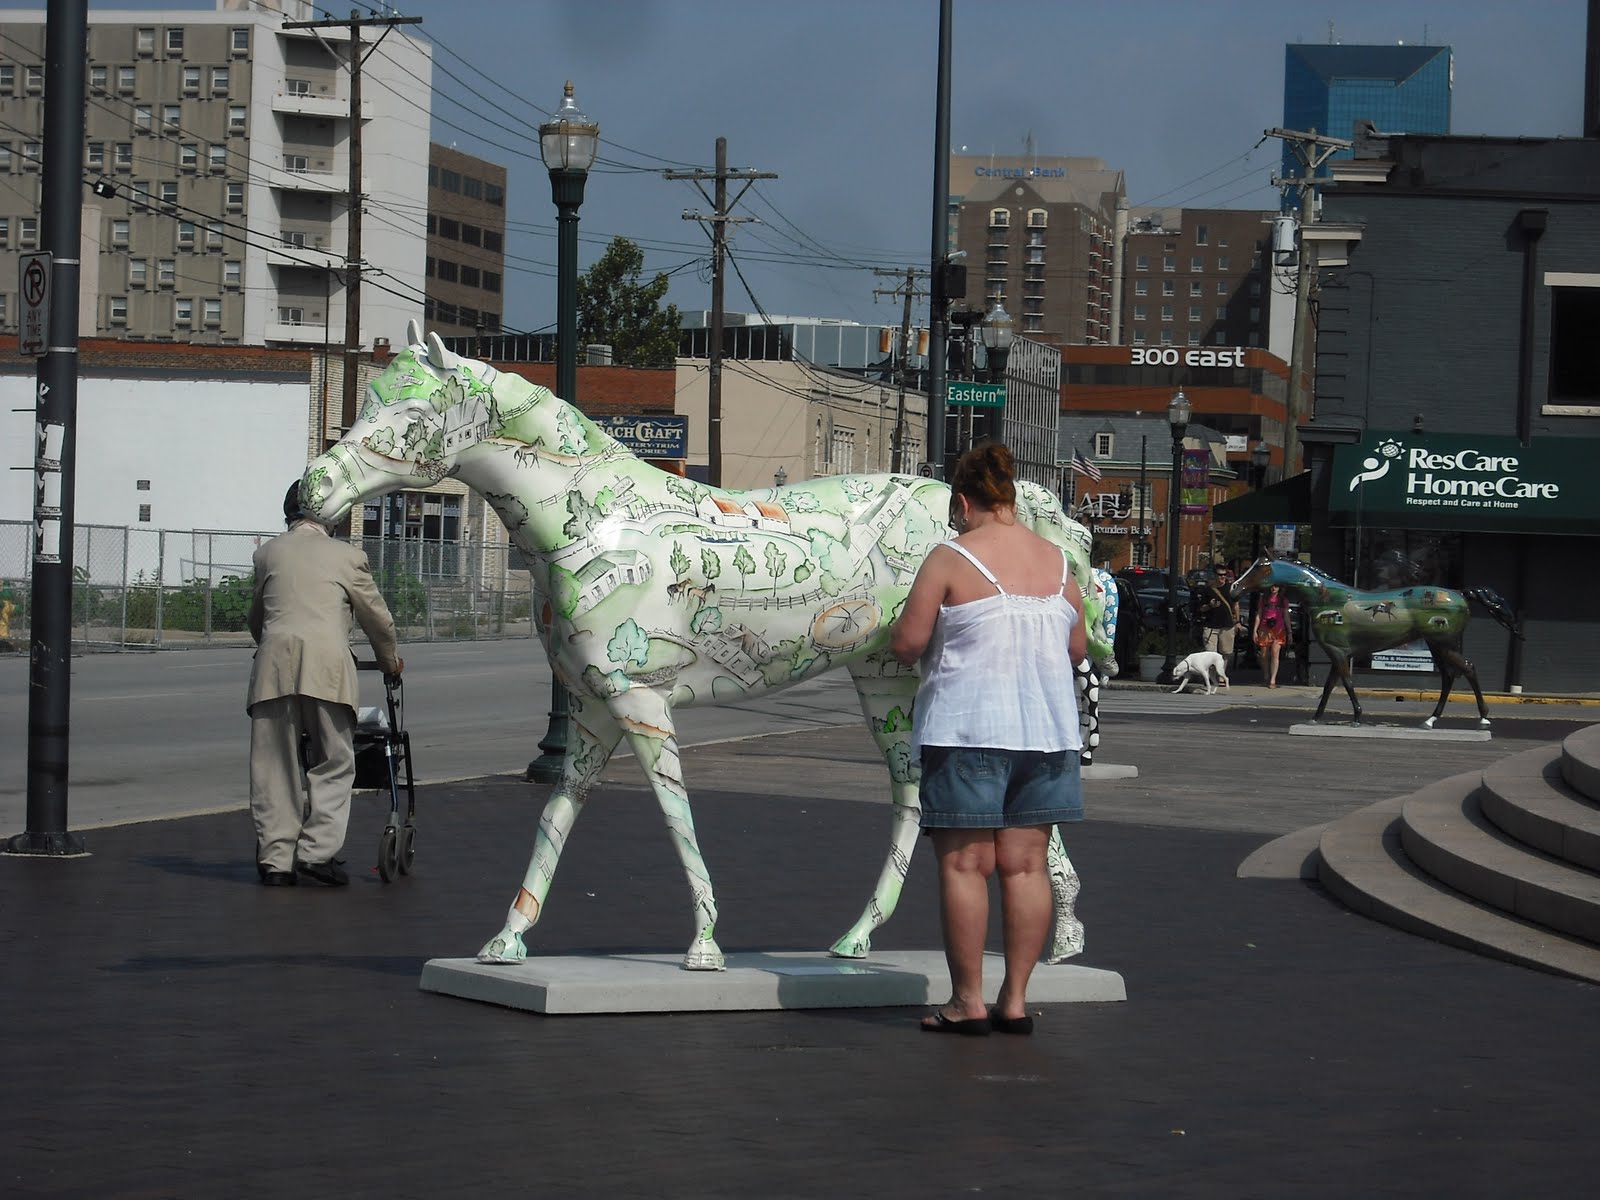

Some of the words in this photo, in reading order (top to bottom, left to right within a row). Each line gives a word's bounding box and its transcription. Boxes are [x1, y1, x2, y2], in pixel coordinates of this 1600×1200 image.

[975, 166, 1025, 177] Central
[1032, 166, 1065, 178] Bank
[1131, 348, 1179, 366] 300
[1185, 346, 1245, 368] east
[947, 386, 996, 403] Eastern
[1409, 448, 1519, 473] ResCare
[1406, 473, 1560, 499] HomeCare
[1406, 497, 1441, 506] Respect
[1460, 499, 1481, 507] Care
[1493, 500, 1519, 509] Home
[1093, 524, 1128, 535] Founders
